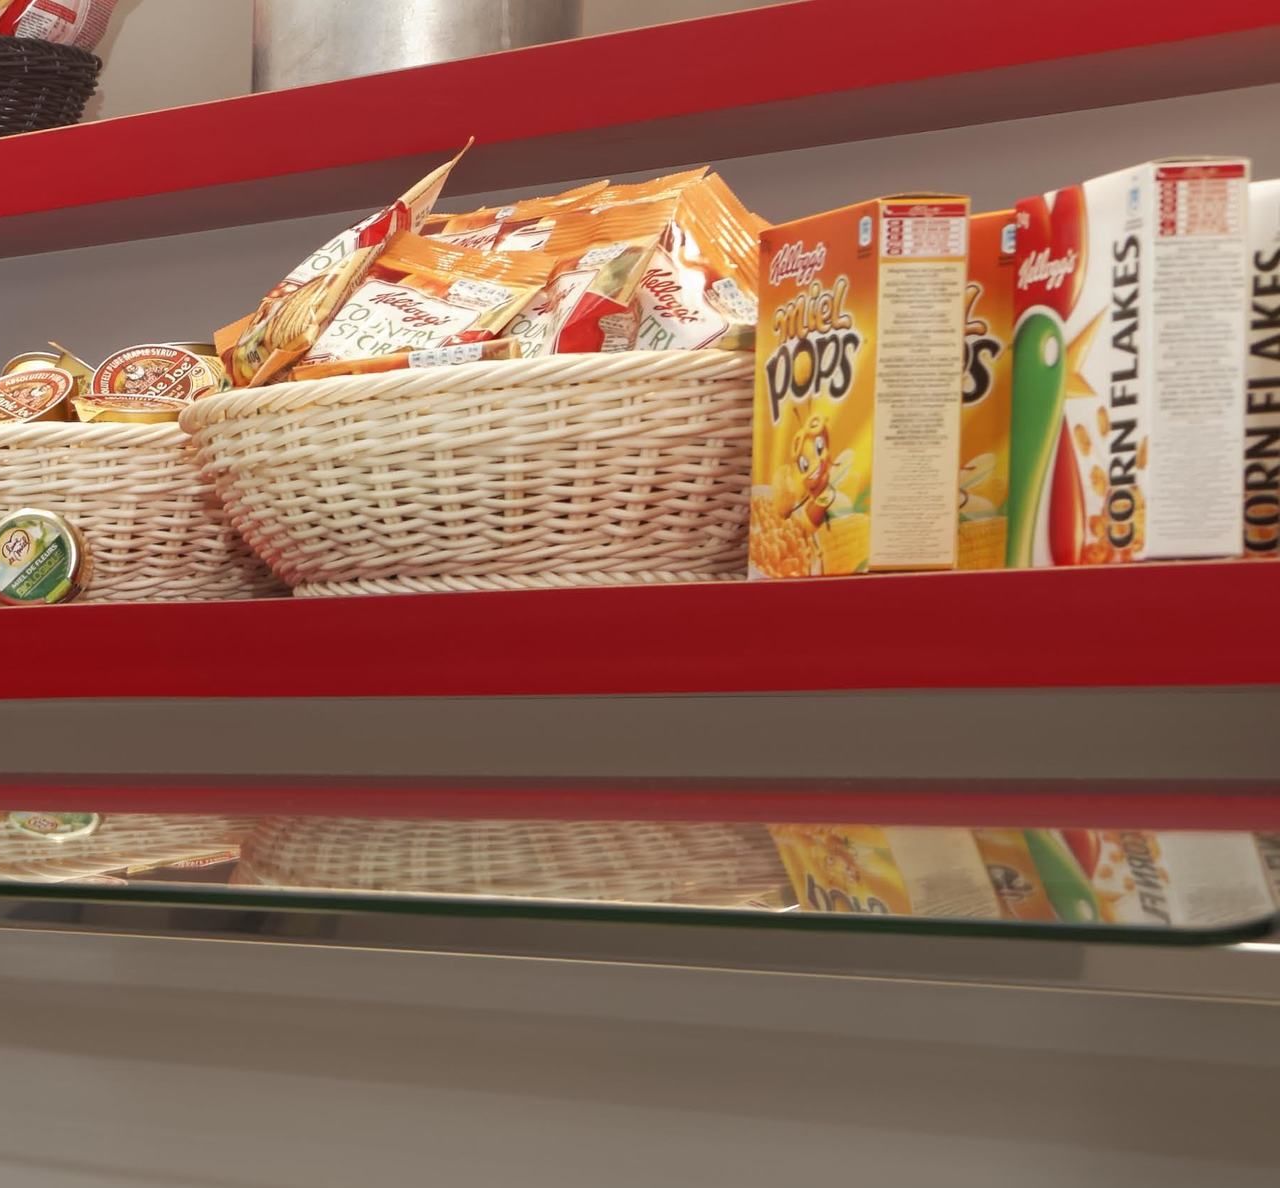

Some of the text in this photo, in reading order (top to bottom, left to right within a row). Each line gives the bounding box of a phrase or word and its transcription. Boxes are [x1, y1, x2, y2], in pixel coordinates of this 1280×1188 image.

[1017, 247, 1079, 293] Kellogg's
[640, 268, 701, 324] Kellogg's
[164, 359, 192, 383] Joe
[1109, 233, 1140, 550] CORN FLAKES
[11, 575, 28, 589] MIEL
[35, 543, 59, 567] FLEURS
